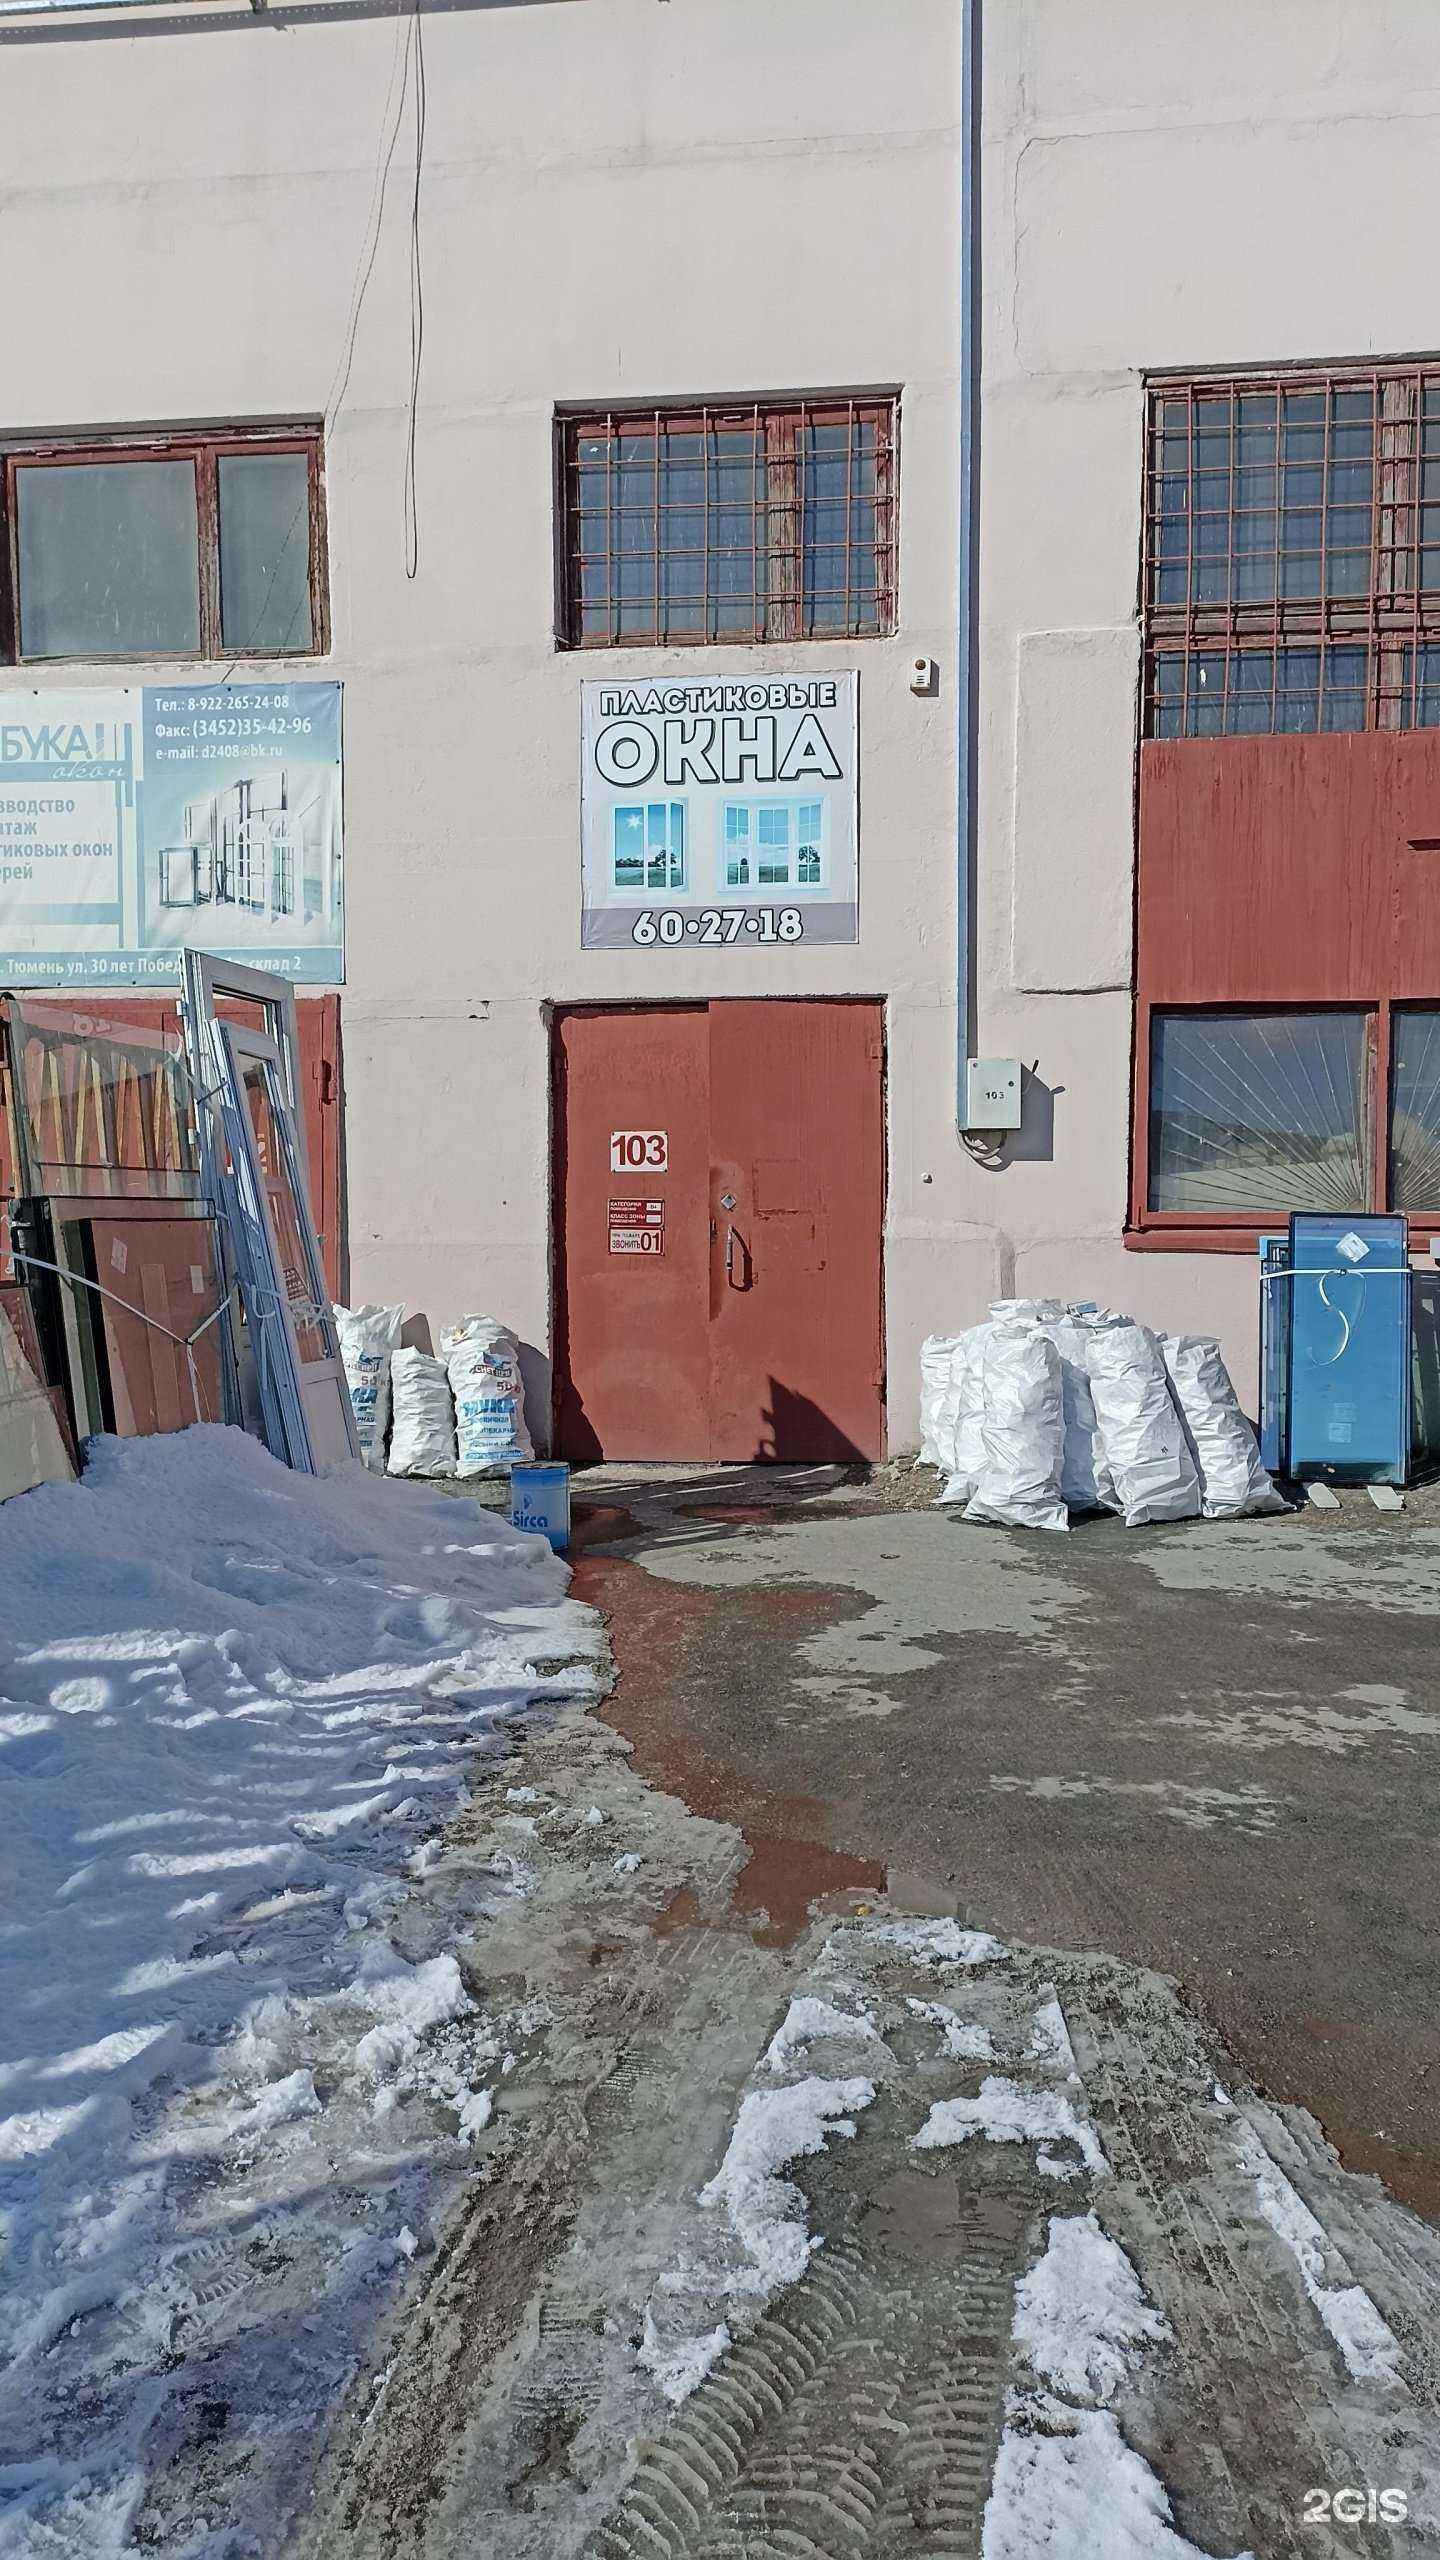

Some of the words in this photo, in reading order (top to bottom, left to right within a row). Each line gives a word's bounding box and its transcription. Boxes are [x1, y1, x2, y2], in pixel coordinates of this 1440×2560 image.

[188, 696, 289, 710] 8-922-265-24-08
[600, 682, 836, 715] ПЛАСТИКОВЫЕ
[155, 724, 190, 737] Факс:
[193, 717, 312, 738] (3452)35-42-96
[156, 747, 199, 759] e-mail:
[595, 714, 843, 787] ОКНА
[72, 843, 113, 857] окон
[8, 959, 64, 974] Тюмень
[67, 960, 88, 977] ул.
[90, 959, 107, 973] 30
[110, 961, 135, 972] лет
[293, 955, 302, 970] 2
[984, 1091, 1005, 1100] 103
[612, 1135, 666, 1166] 103
[641, 1232, 660, 1251] 01
[513, 1510, 548, 1528] Sirca
